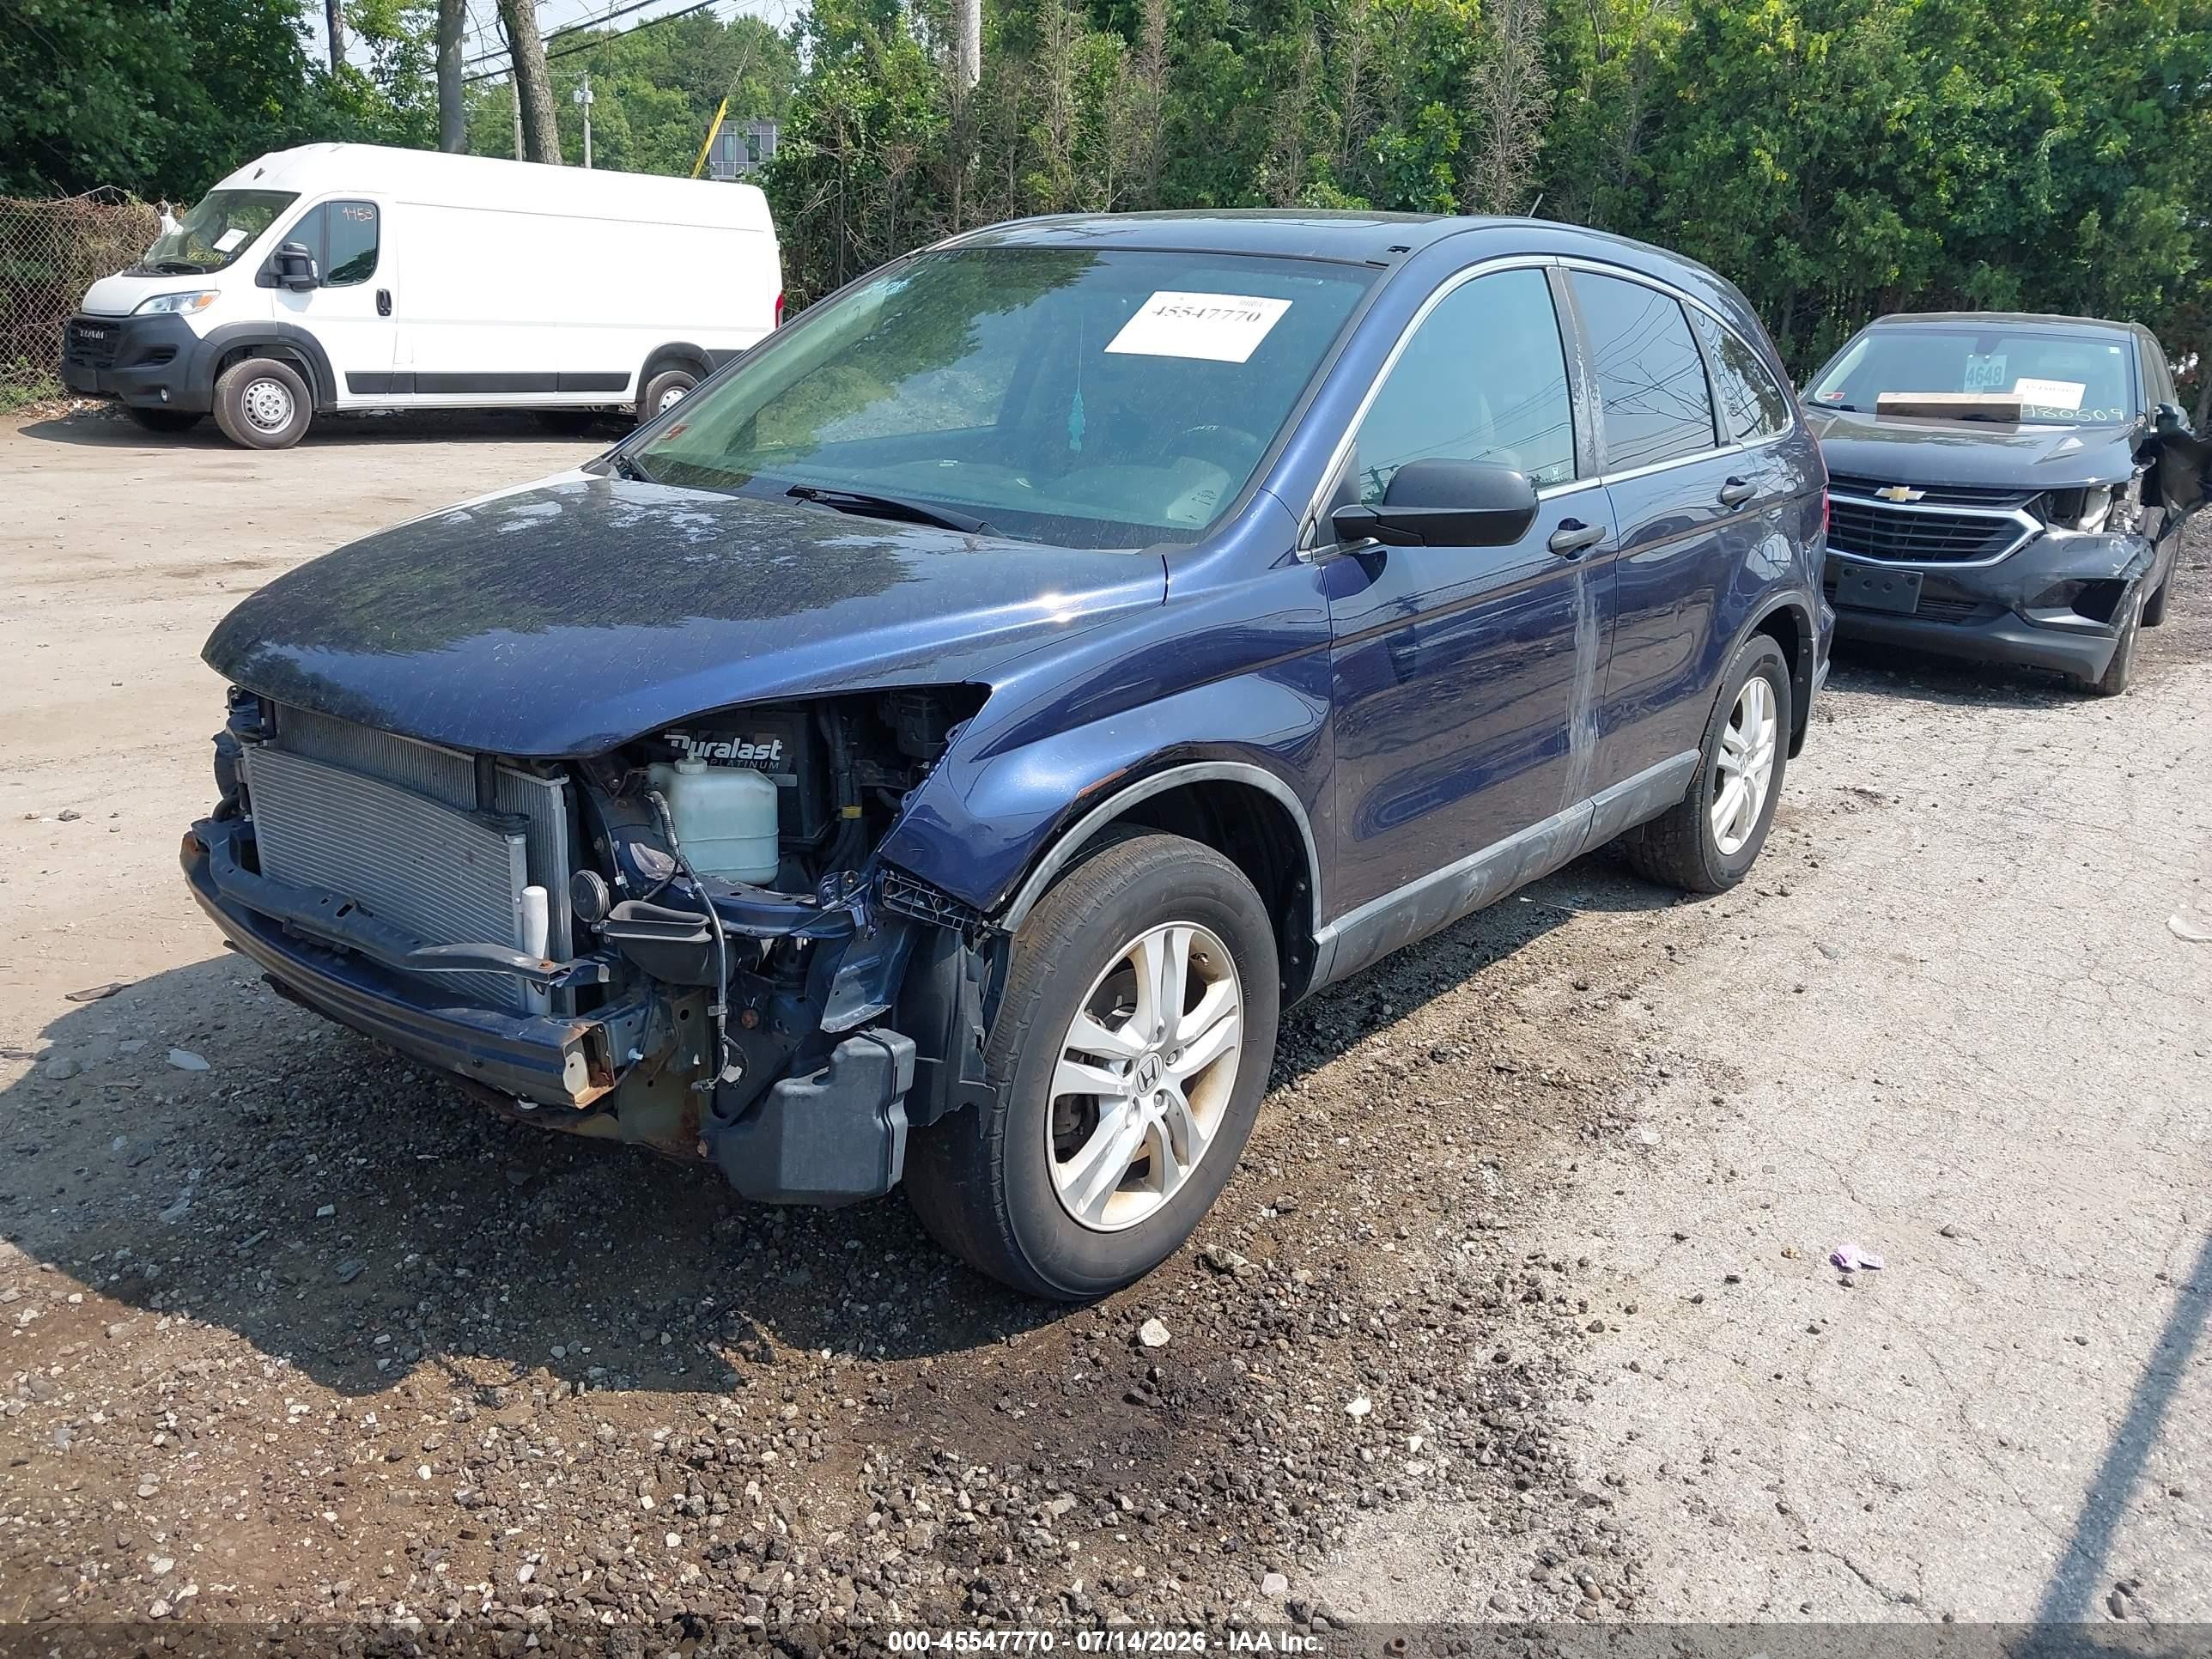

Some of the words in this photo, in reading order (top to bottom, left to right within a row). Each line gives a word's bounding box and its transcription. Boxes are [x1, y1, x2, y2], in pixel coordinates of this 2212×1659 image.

[1152, 306, 1262, 323] 45547770
[1966, 365, 2002, 386] 4648
[664, 734, 783, 761] Duralast
[710, 758, 780, 769] PLATINUM
